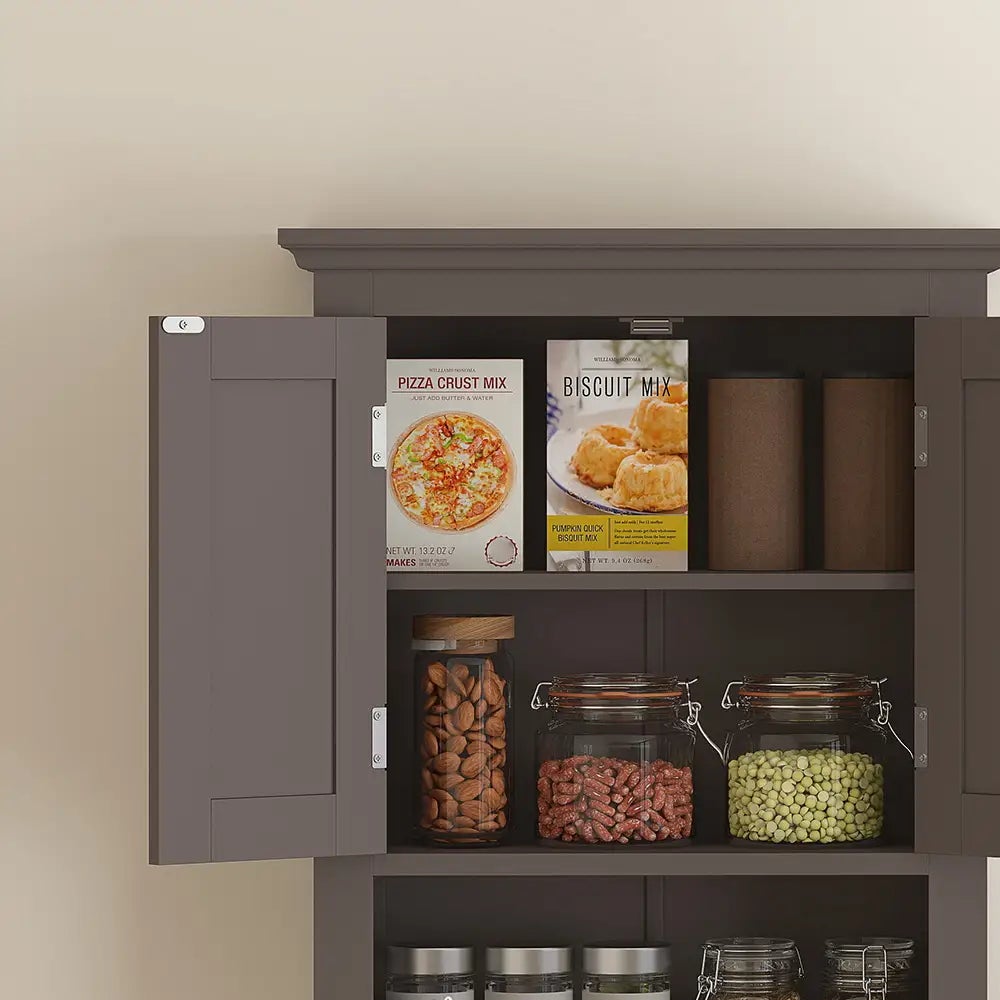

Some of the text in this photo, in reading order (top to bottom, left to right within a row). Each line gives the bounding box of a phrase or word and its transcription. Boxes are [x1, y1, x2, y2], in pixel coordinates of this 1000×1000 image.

[398, 376, 507, 389] PIZZA CRUST MIX
[563, 376, 671, 397] BISCUIT MIX
[551, 524, 582, 533] PUMPKIN
[583, 524, 604, 533] QUICK
[585, 534, 598, 542] MIX
[386, 546, 401, 555] NET
[419, 546, 435, 555] 13.2
[436, 546, 447, 555] OZ
[387, 558, 416, 567] MAKES
